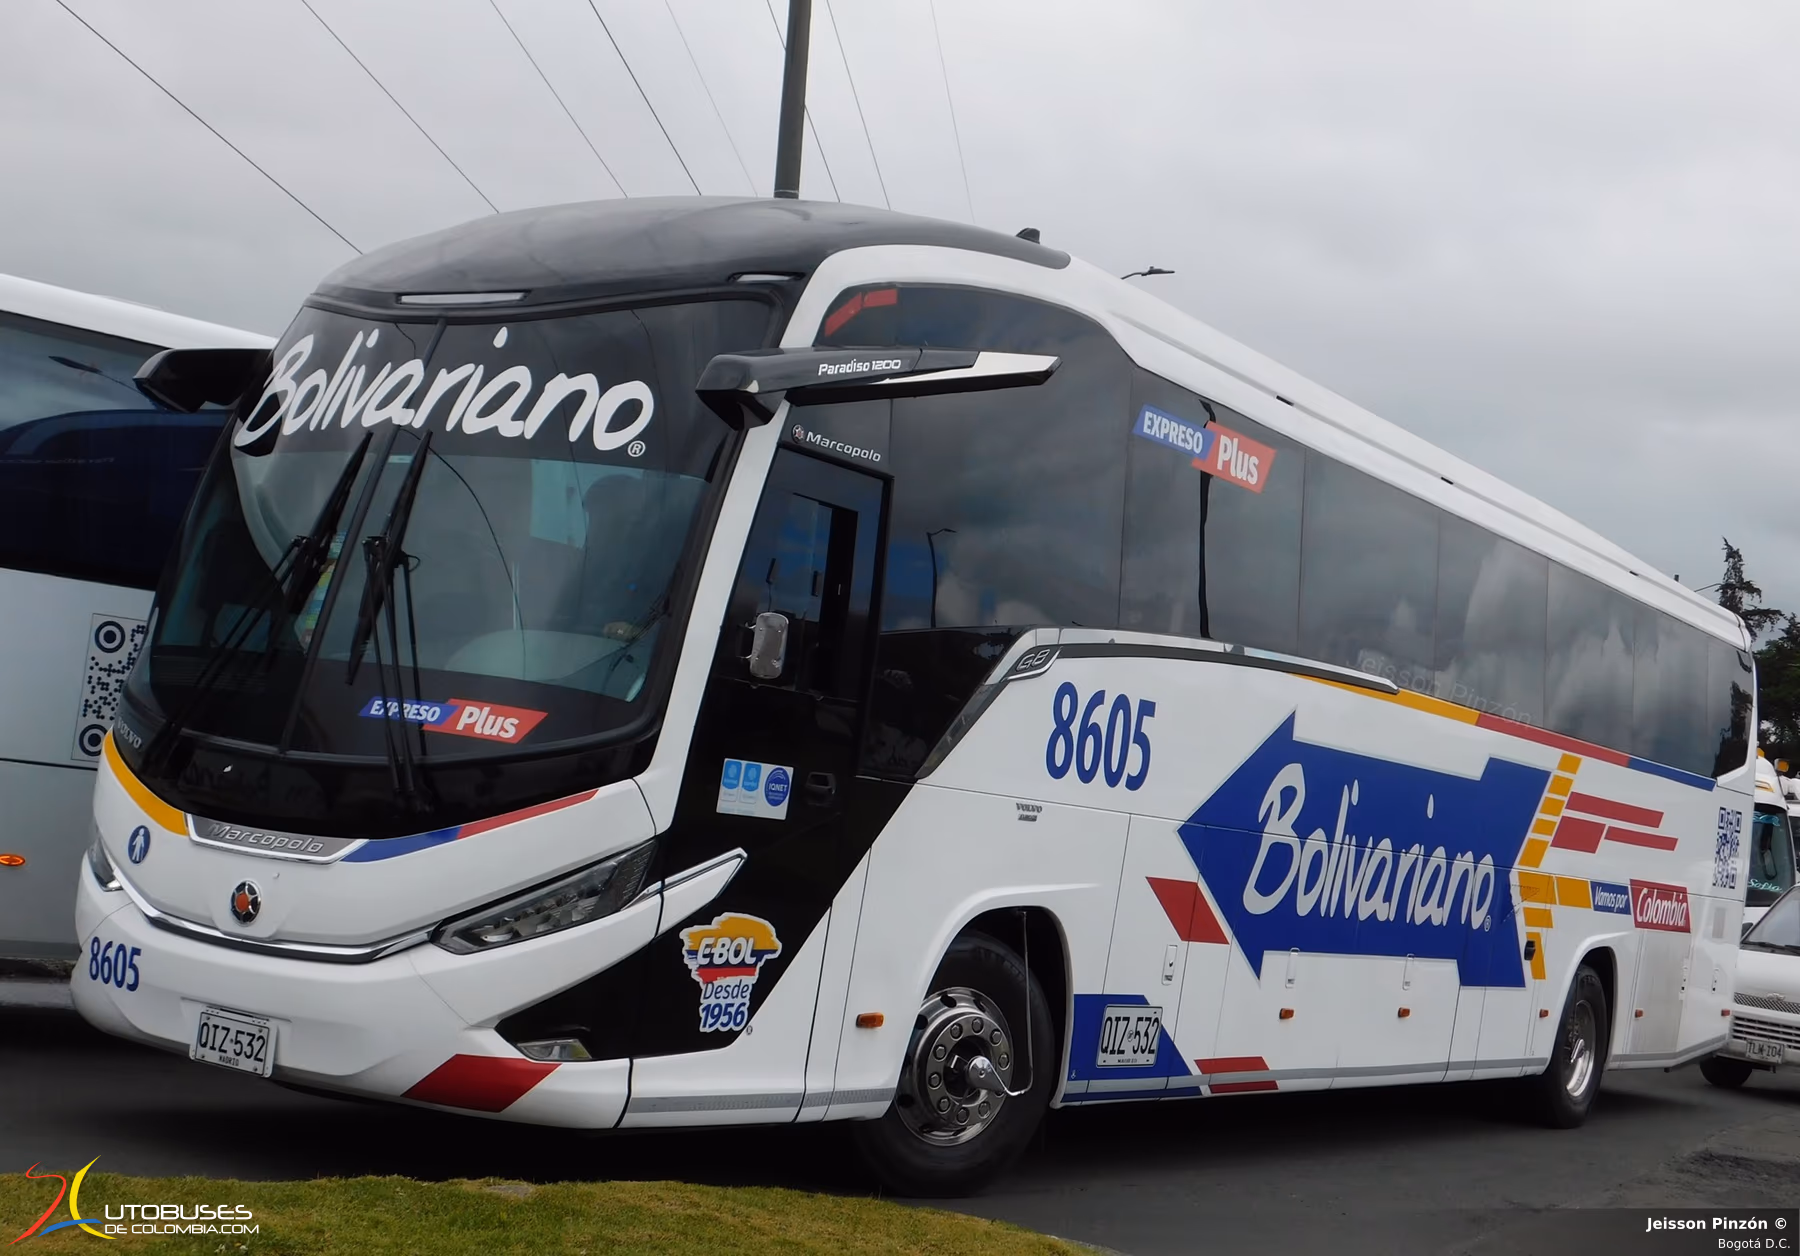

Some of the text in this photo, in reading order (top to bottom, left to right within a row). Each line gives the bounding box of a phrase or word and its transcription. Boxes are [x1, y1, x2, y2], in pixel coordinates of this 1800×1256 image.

[818, 359, 902, 376] Paradiso 1200
[234, 326, 654, 451] Bolivariano
[806, 431, 881, 462] Marcopolo
[1143, 410, 1260, 485] EXPRESO Plus
[118, 716, 142, 749] VOLVO
[456, 706, 520, 739] Plus
[1046, 681, 1157, 791] 8605
[207, 822, 324, 853] Marcopolo
[1243, 763, 1495, 930] Bolivariano
[1595, 886, 1687, 927] Vamos por Colombia
[89, 936, 142, 992] 8605
[703, 979, 750, 1000] Desde
[701, 1002, 747, 1029] 1956
